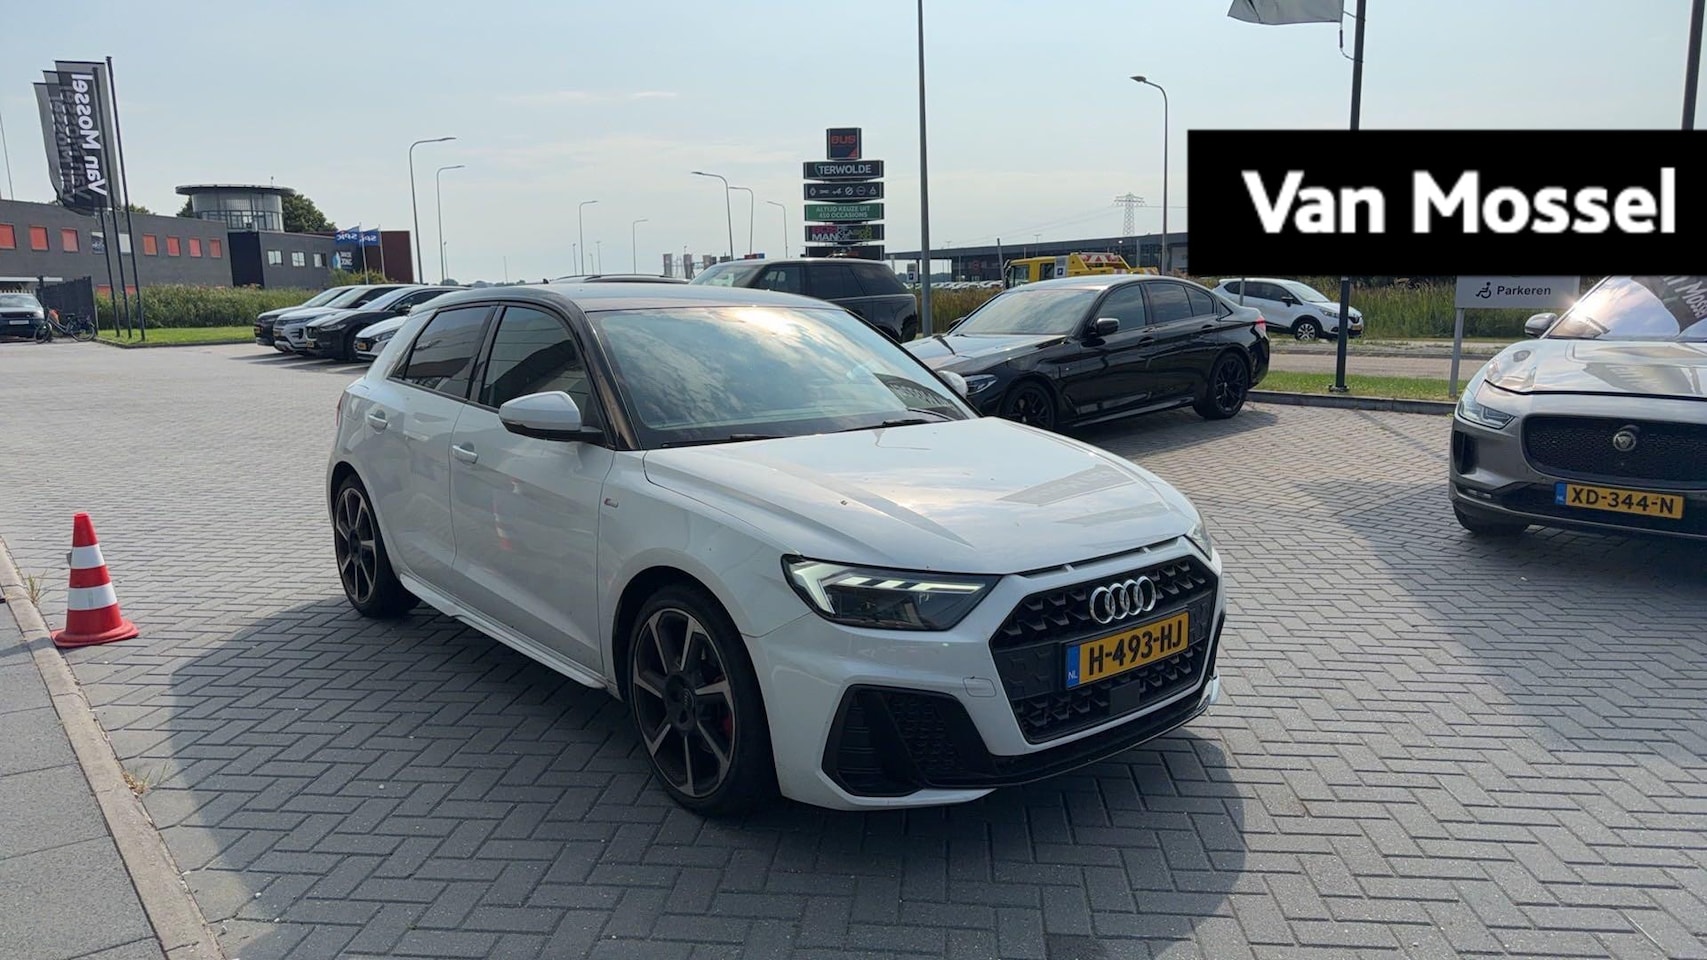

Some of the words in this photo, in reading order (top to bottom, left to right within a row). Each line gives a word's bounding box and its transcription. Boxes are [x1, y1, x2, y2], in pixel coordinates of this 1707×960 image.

[818, 164, 872, 175] TERWOLDE
[1497, 285, 1551, 296] Parkeren
[1571, 487, 1674, 515] XD-344-N
[1089, 620, 1182, 676] H-493-HJ
[1067, 671, 1078, 680] NL
